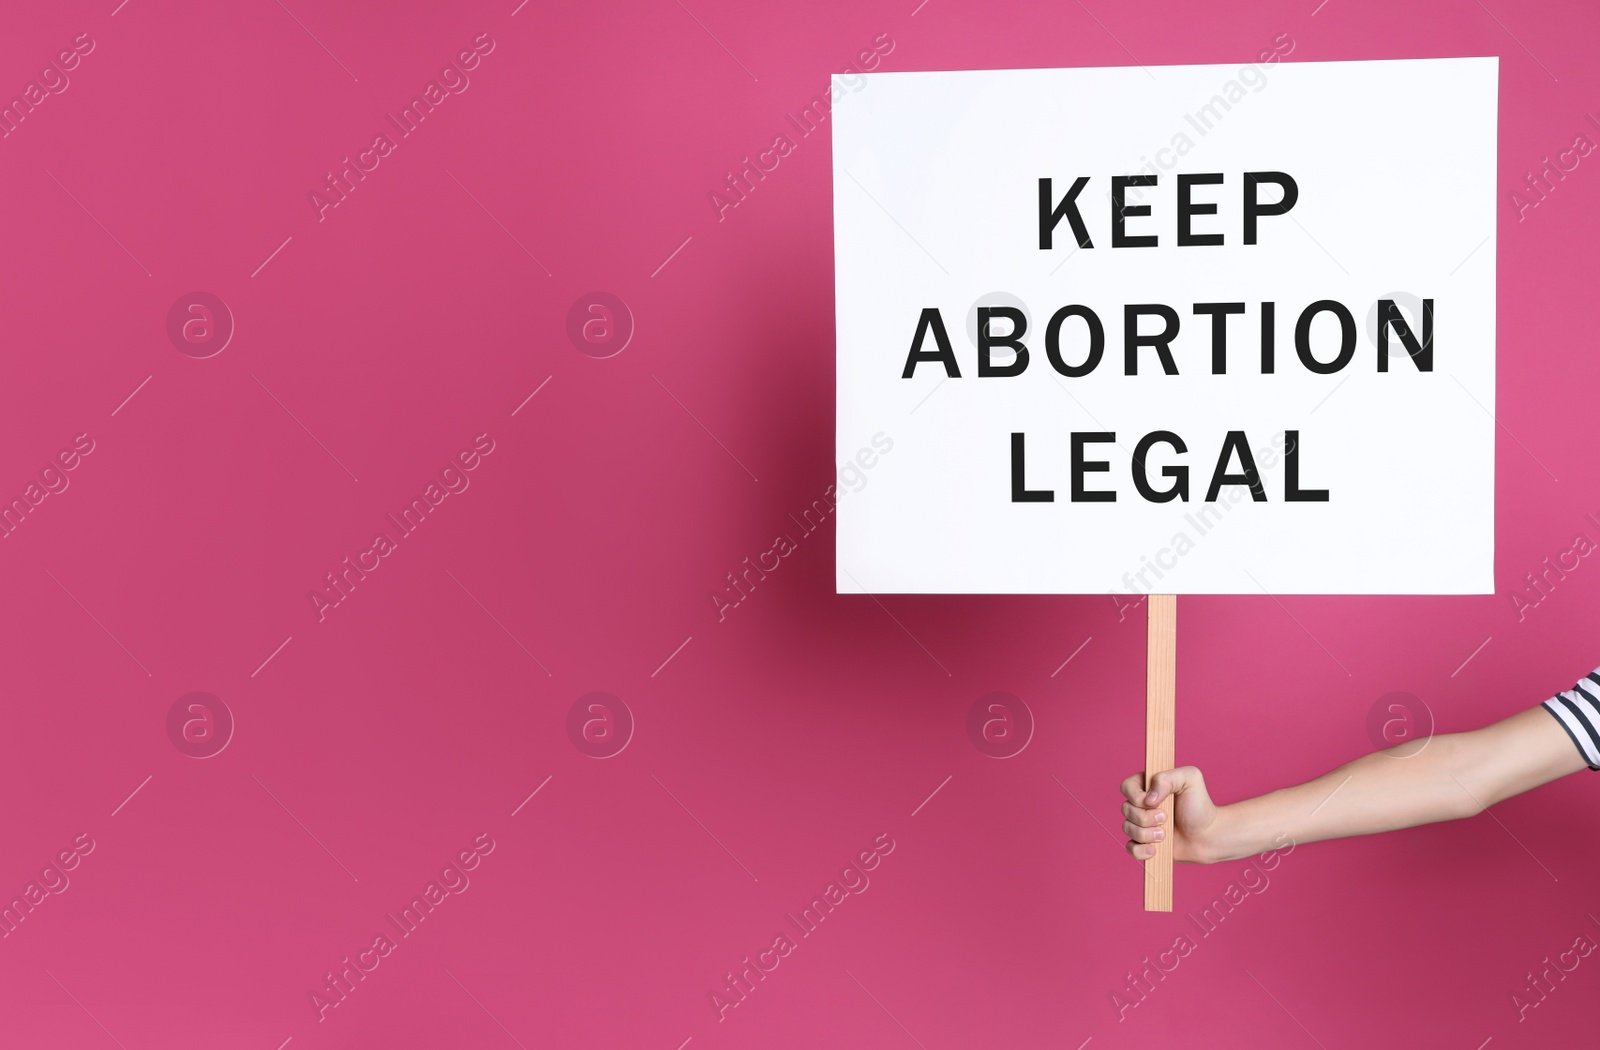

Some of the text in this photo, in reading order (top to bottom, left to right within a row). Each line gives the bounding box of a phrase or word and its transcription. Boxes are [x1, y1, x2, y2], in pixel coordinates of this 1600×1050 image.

[1038, 171, 1299, 250] KEEP
[901, 299, 1435, 379] ABORTION
[1010, 430, 1330, 504] LEGAL
